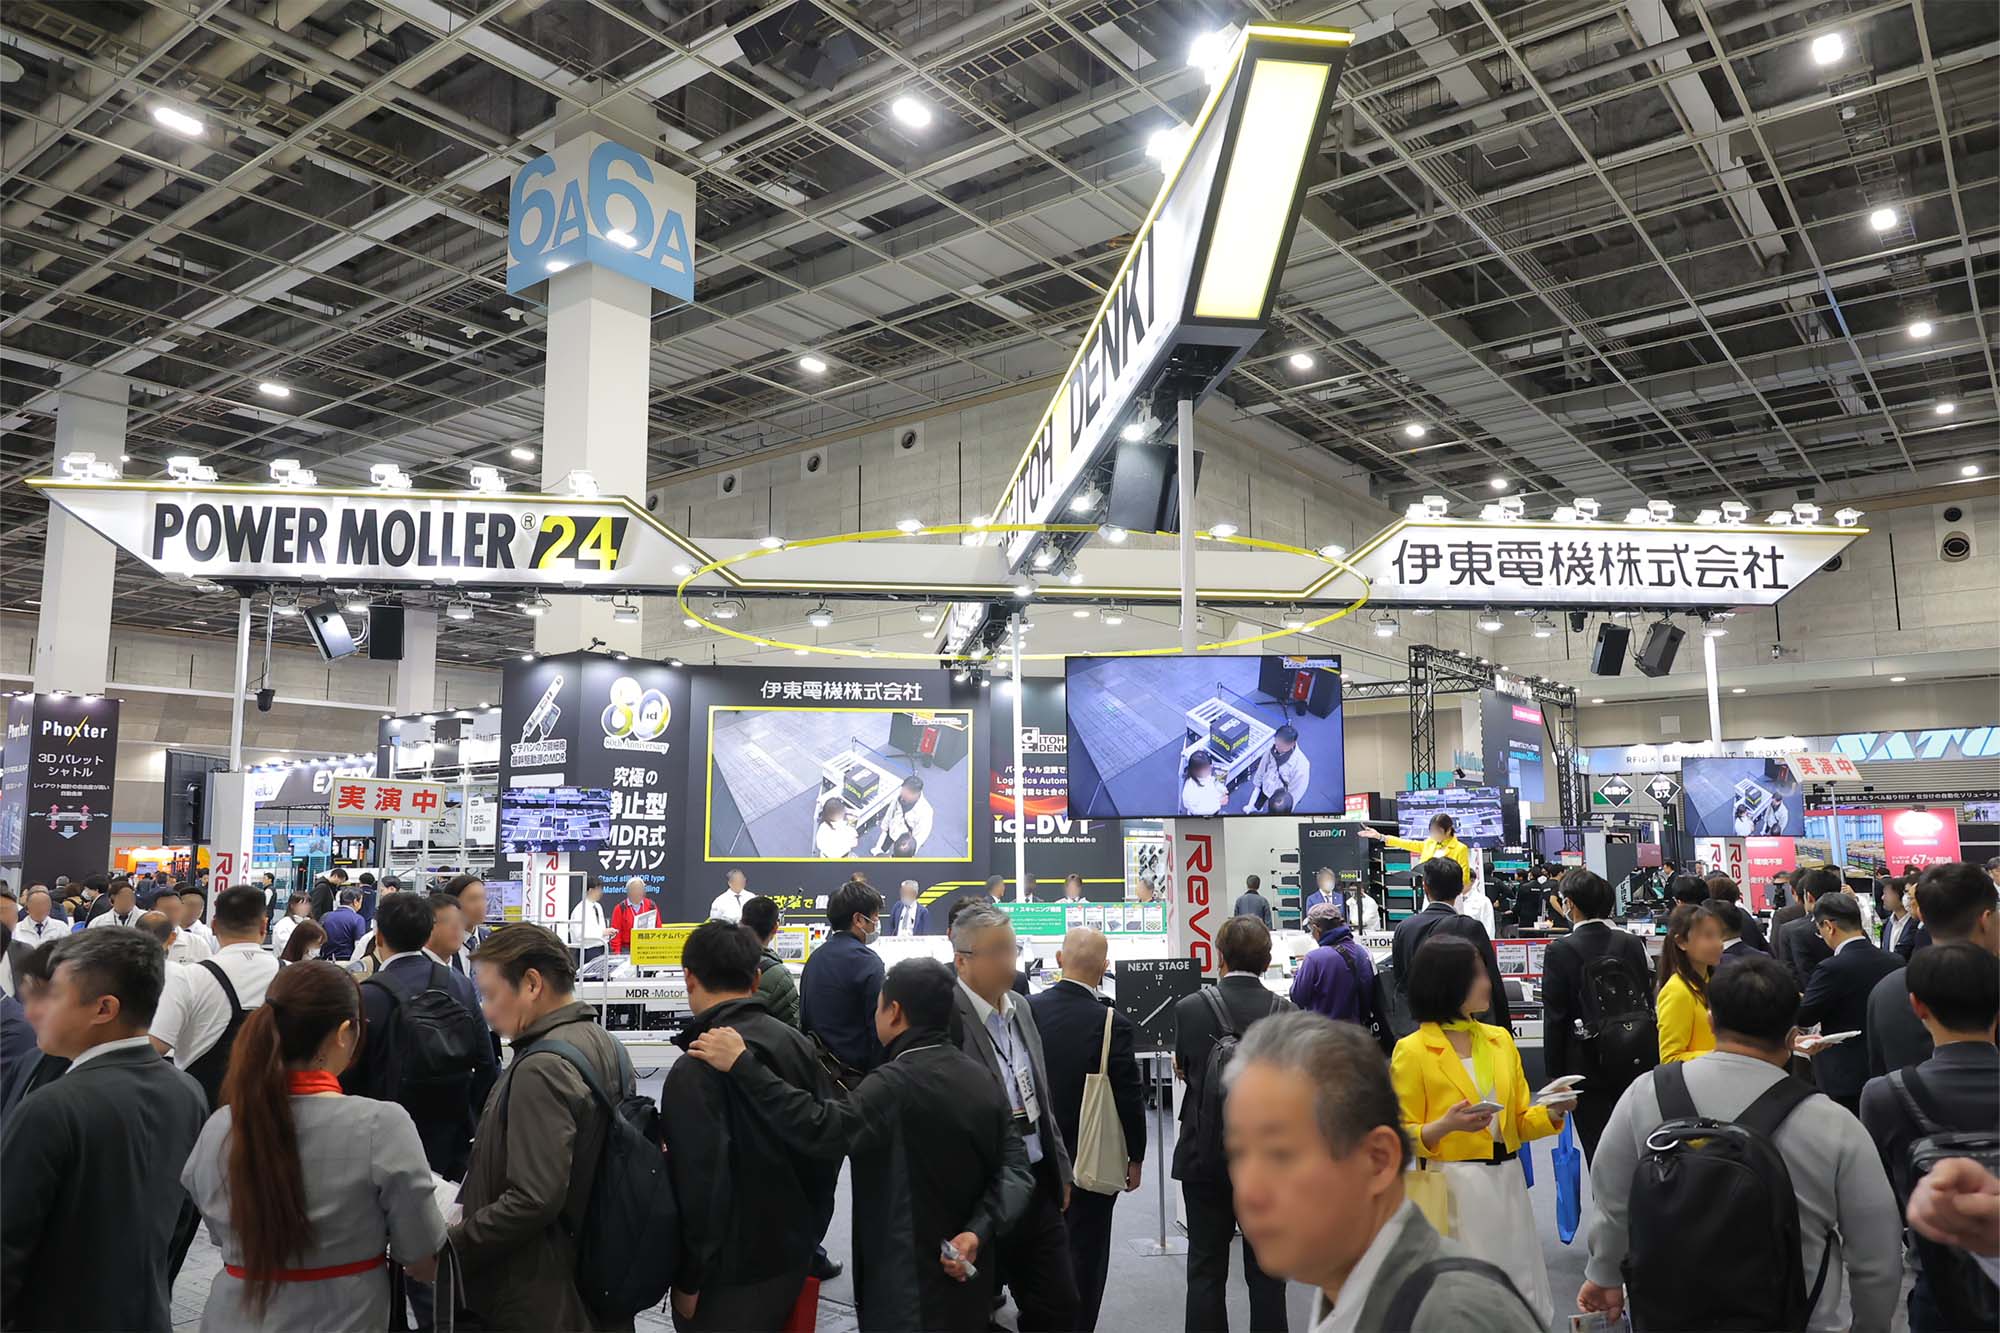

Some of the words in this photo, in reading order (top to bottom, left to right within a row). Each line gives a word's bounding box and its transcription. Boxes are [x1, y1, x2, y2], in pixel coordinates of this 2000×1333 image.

[509, 155, 588, 264] 6A
[588, 141, 695, 277] 6A
[1070, 224, 1154, 452] DENKI
[152, 502, 328, 564] POWER
[537, 514, 618, 570] 24
[1392, 539, 1789, 590] 伊東電機株式会社
[760, 680, 923, 701] 伊東電機株式会社
[42, 717, 108, 741] Phoxter
[625, 739, 667, 752] Anniversary
[1039, 736, 1065, 744] ITOH
[1039, 744, 1067, 752] DENK
[1831, 727, 2000, 761] SATO
[37, 753, 57, 763] 3D
[1796, 756, 1853, 775] 実演中
[48, 767, 94, 777] シャトル
[612, 766, 658, 788] 究極の
[338, 785, 438, 813] 実演中
[1654, 790, 1671, 799] DX
[598, 849, 666, 871] マテハン
[651, 875, 666, 884] type
[1127, 962, 1153, 972] NEXT
[1158, 961, 1190, 970] STAGE
[625, 989, 649, 998] MDR
